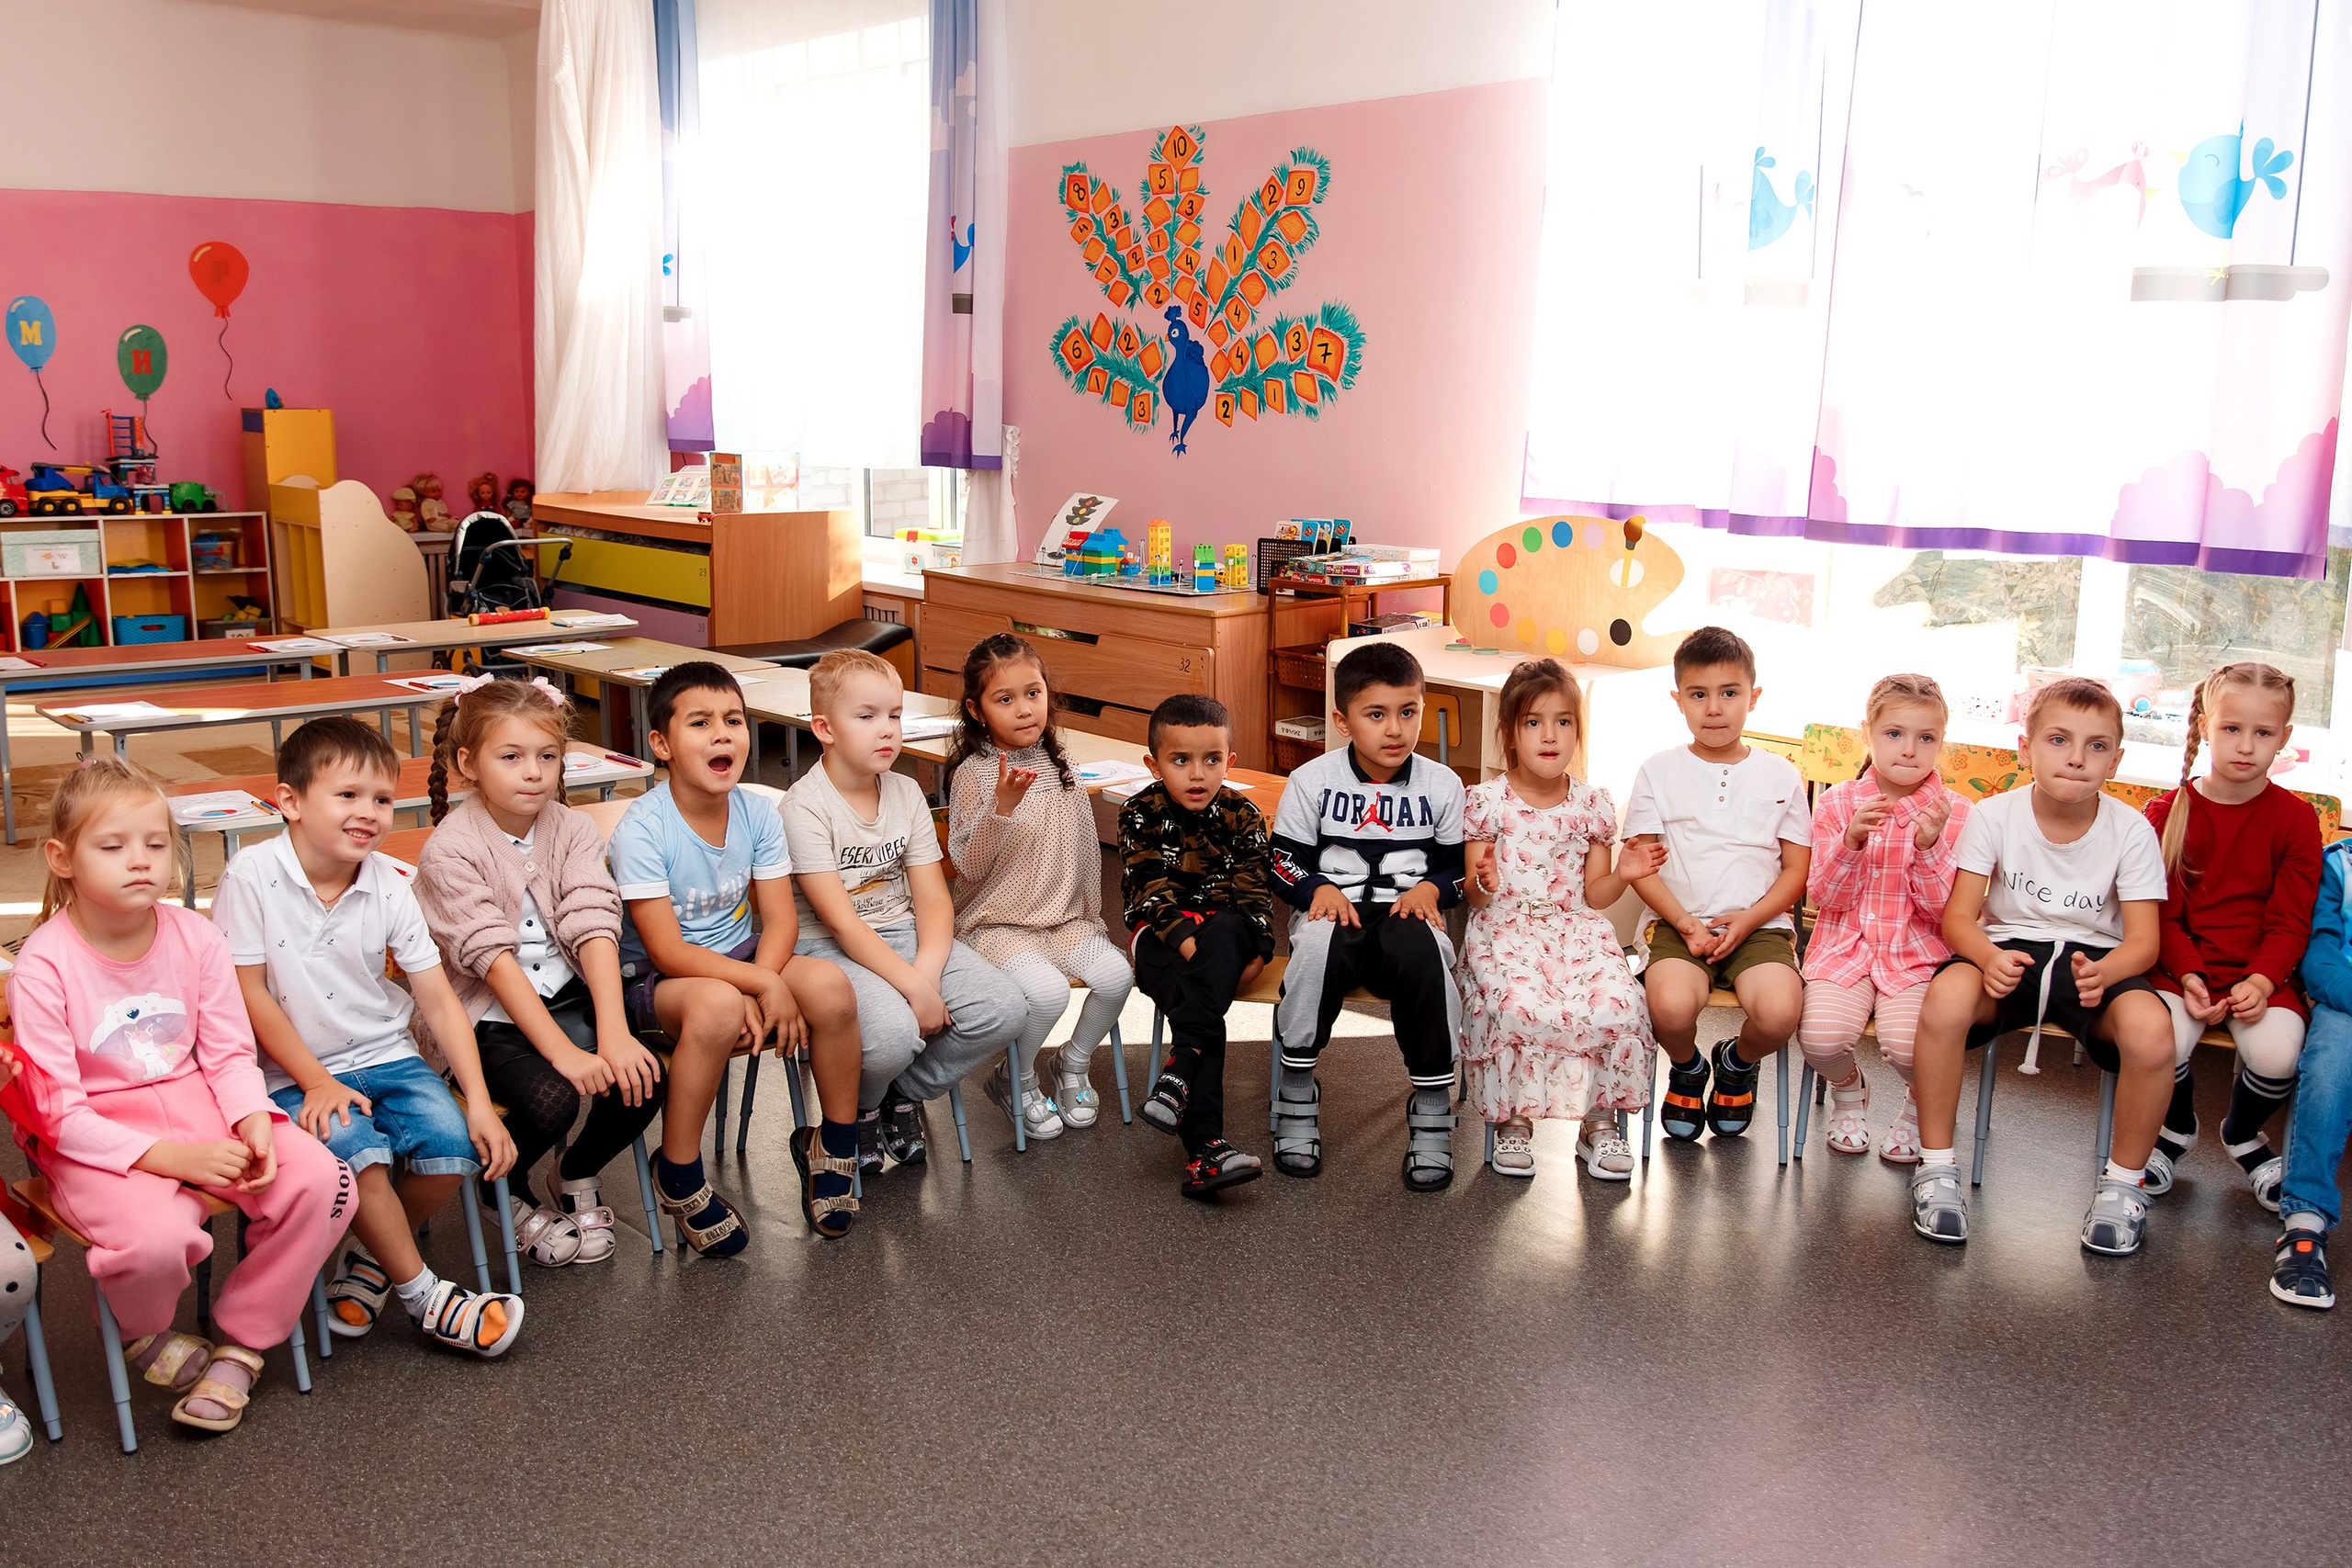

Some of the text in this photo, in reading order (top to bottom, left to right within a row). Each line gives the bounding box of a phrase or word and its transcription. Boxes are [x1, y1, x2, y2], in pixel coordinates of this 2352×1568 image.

[1172, 136, 1188, 159] 10
[1158, 168, 1168, 190] 5
[1295, 177, 1306, 197] 9
[1072, 182, 1086, 202] 8
[1267, 184, 1278, 207] 2
[1184, 199, 1194, 215] 3
[1109, 211, 1120, 230] 3
[1131, 251, 1142, 265] 2
[1185, 254, 1193, 271] 4
[1266, 250, 1277, 270] 3
[1154, 288, 1163, 305] 2
[1193, 301, 1203, 315] 5
[1233, 303, 1241, 322] 4
[1071, 339, 1082, 359] 6
[1123, 332, 1135, 352] 2
[1291, 330, 1302, 353] 3
[1235, 345, 1244, 367] 4
[1317, 342, 1333, 365] 7
[1137, 400, 1146, 418] 3
[1221, 400, 1231, 419] 2
[699, 568, 707, 577] 29
[1179, 657, 1191, 672] 32
[119, 739, 125, 750] 1
[1320, 787, 1434, 827] JORDAN
[875, 836, 906, 863] VIBES
[2003, 870, 2107, 913] Nice day
[1160, 1074, 1183, 1086] SPORT
